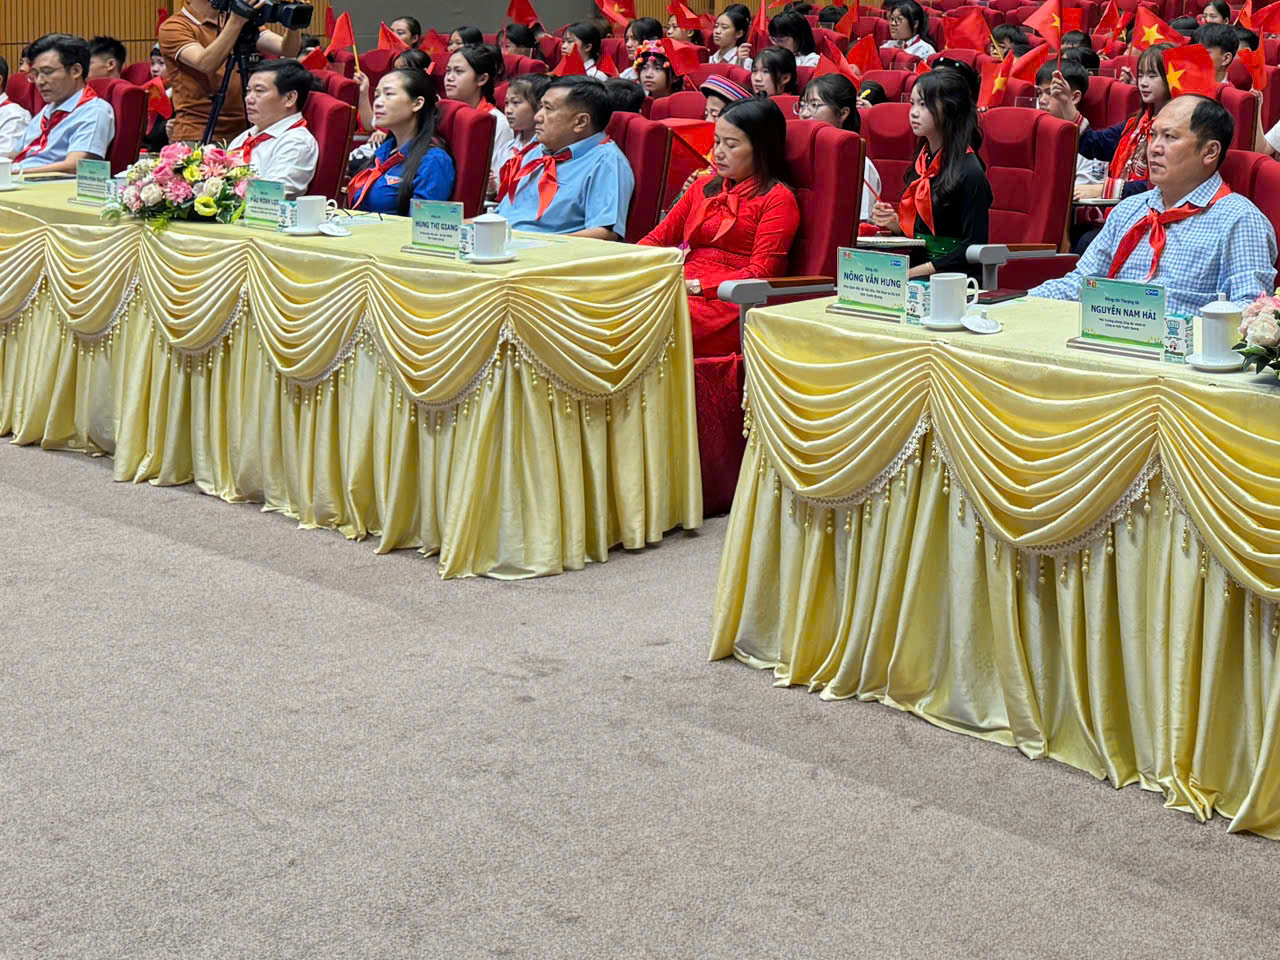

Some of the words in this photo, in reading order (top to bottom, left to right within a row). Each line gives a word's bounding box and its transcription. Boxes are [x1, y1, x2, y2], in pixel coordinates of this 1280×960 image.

[844, 270, 863, 283] NÔNG
[865, 273, 879, 285] VĂN
[881, 277, 901, 288] HƯNG
[1123, 309, 1140, 318] NAM
